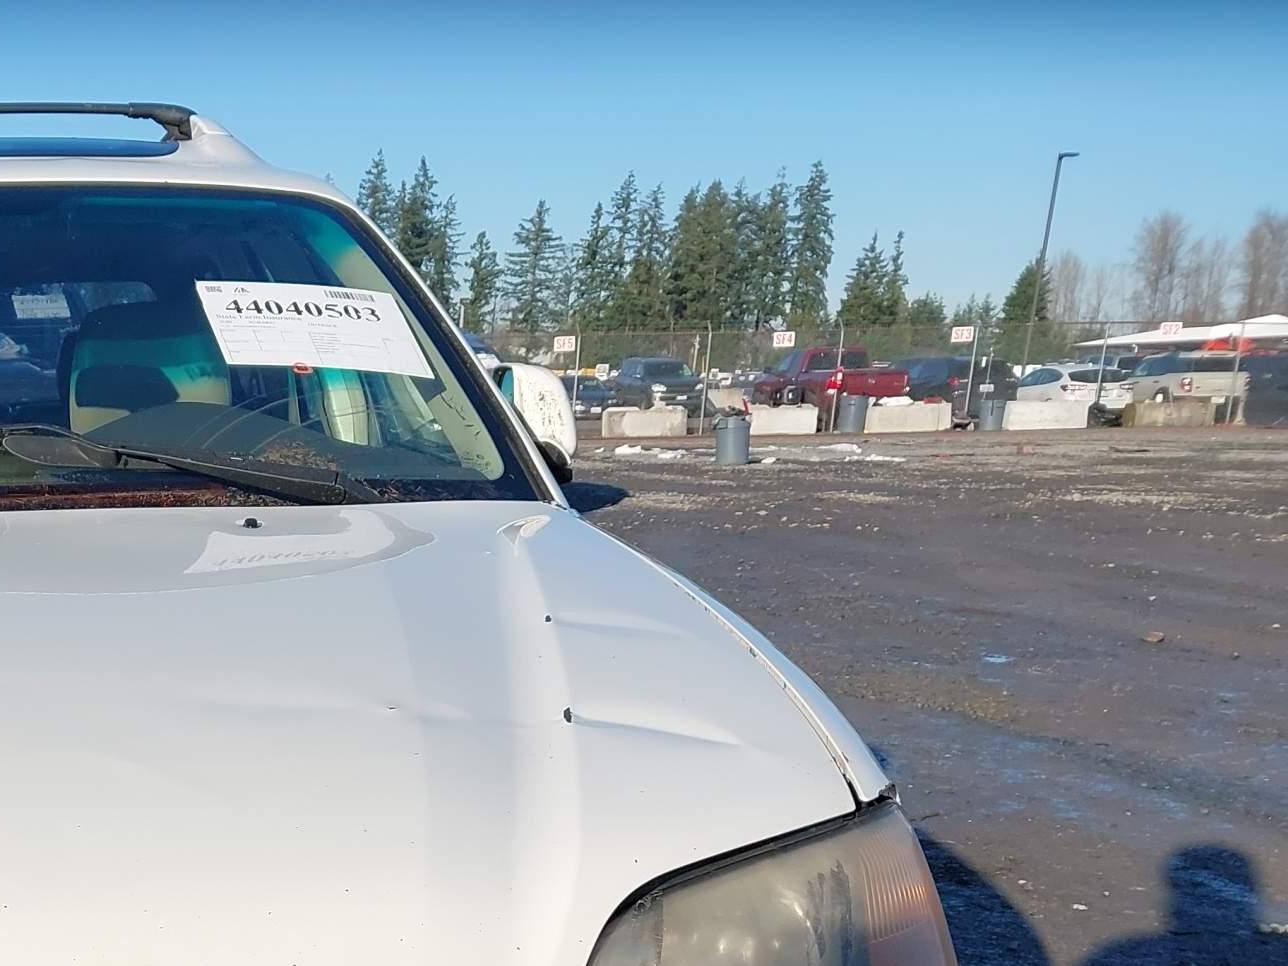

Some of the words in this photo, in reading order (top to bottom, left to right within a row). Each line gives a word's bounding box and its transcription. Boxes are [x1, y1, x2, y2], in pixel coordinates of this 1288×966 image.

[226, 299, 381, 322] 44040503
[953, 328, 972, 340] SF3
[1162, 323, 1181, 335] SF2
[556, 338, 574, 350] SF5
[775, 333, 793, 345] SF4
